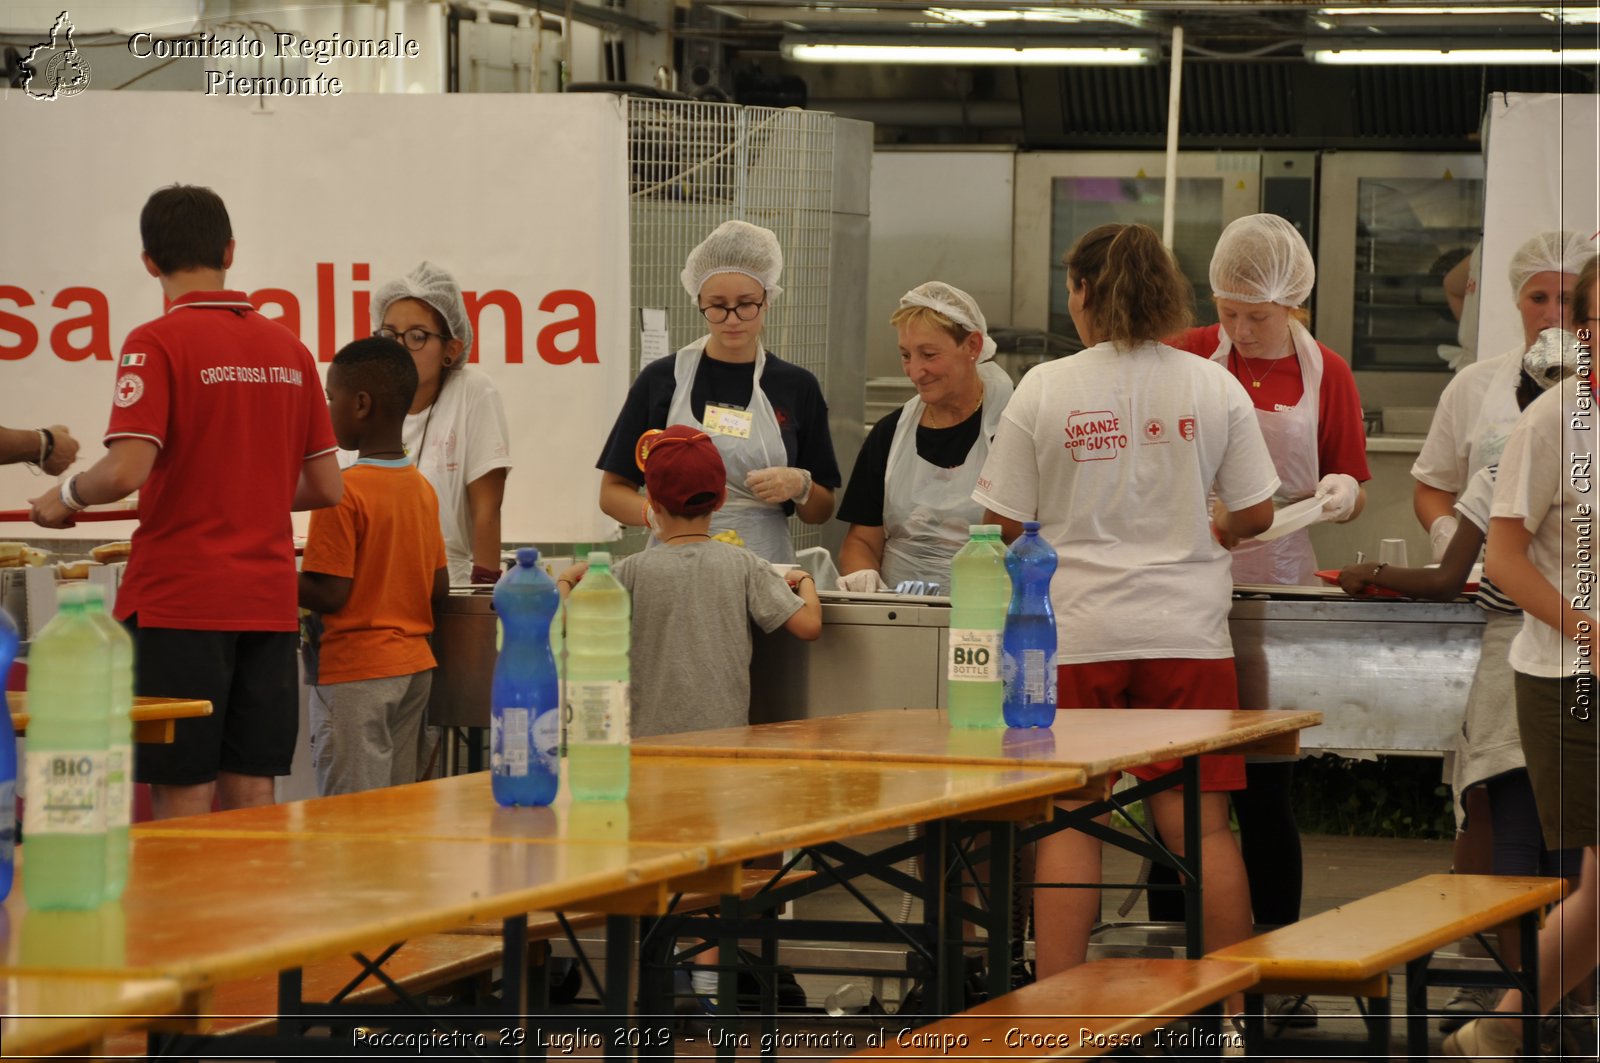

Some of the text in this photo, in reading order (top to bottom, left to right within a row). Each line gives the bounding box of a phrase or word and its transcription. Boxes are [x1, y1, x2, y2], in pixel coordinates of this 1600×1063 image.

[200, 366, 236, 385] CROCE
[237, 366, 267, 383] ROSSA
[1064, 417, 1120, 440] VACANZE
[1064, 434, 1128, 451] con GUSTO
[954, 647, 990, 666] BIO
[953, 665, 989, 675] BOTTLE
[52, 757, 93, 777] BIO
